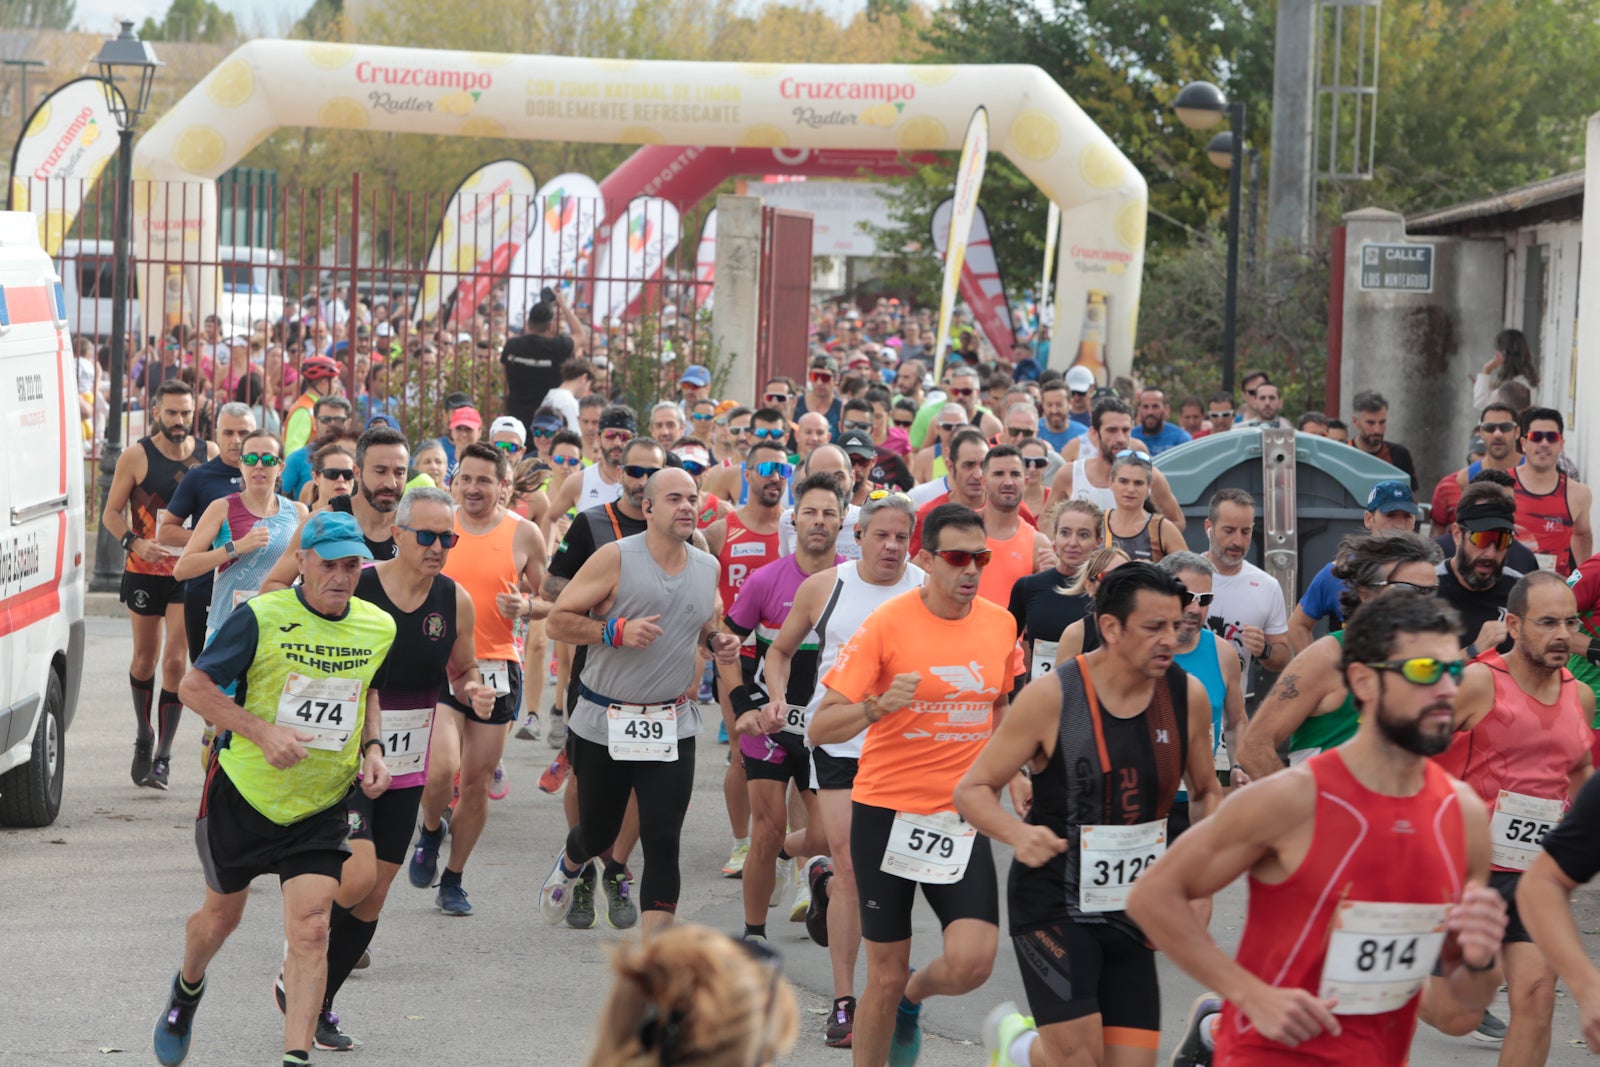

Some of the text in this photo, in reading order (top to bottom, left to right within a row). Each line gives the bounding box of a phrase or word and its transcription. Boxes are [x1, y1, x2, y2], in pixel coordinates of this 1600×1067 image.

[355, 61, 493, 91] Cruzcampo
[526, 79, 555, 97] CON
[560, 80, 600, 98] ZUMO
[604, 82, 668, 100] NATURAL
[672, 84, 692, 101] DE
[778, 77, 916, 102] Cruzcampo
[368, 91, 434, 114] Radler
[526, 98, 742, 124] DOBLEMENTE REFRESCANTE
[792, 105, 858, 129] Radler
[33, 106, 94, 182] Cruzcampo
[1071, 245, 1133, 263] Cruzcampo
[1385, 248, 1426, 261] CALLE
[13, 531, 39, 593] Española
[280, 642, 373, 657] ATLETISMO
[286, 652, 370, 674] ALHENDÍN
[296, 700, 343, 725] 474
[624, 720, 664, 740] 439
[387, 732, 412, 753] 11
[907, 827, 955, 859] 579
[1356, 937, 1419, 972] 814
